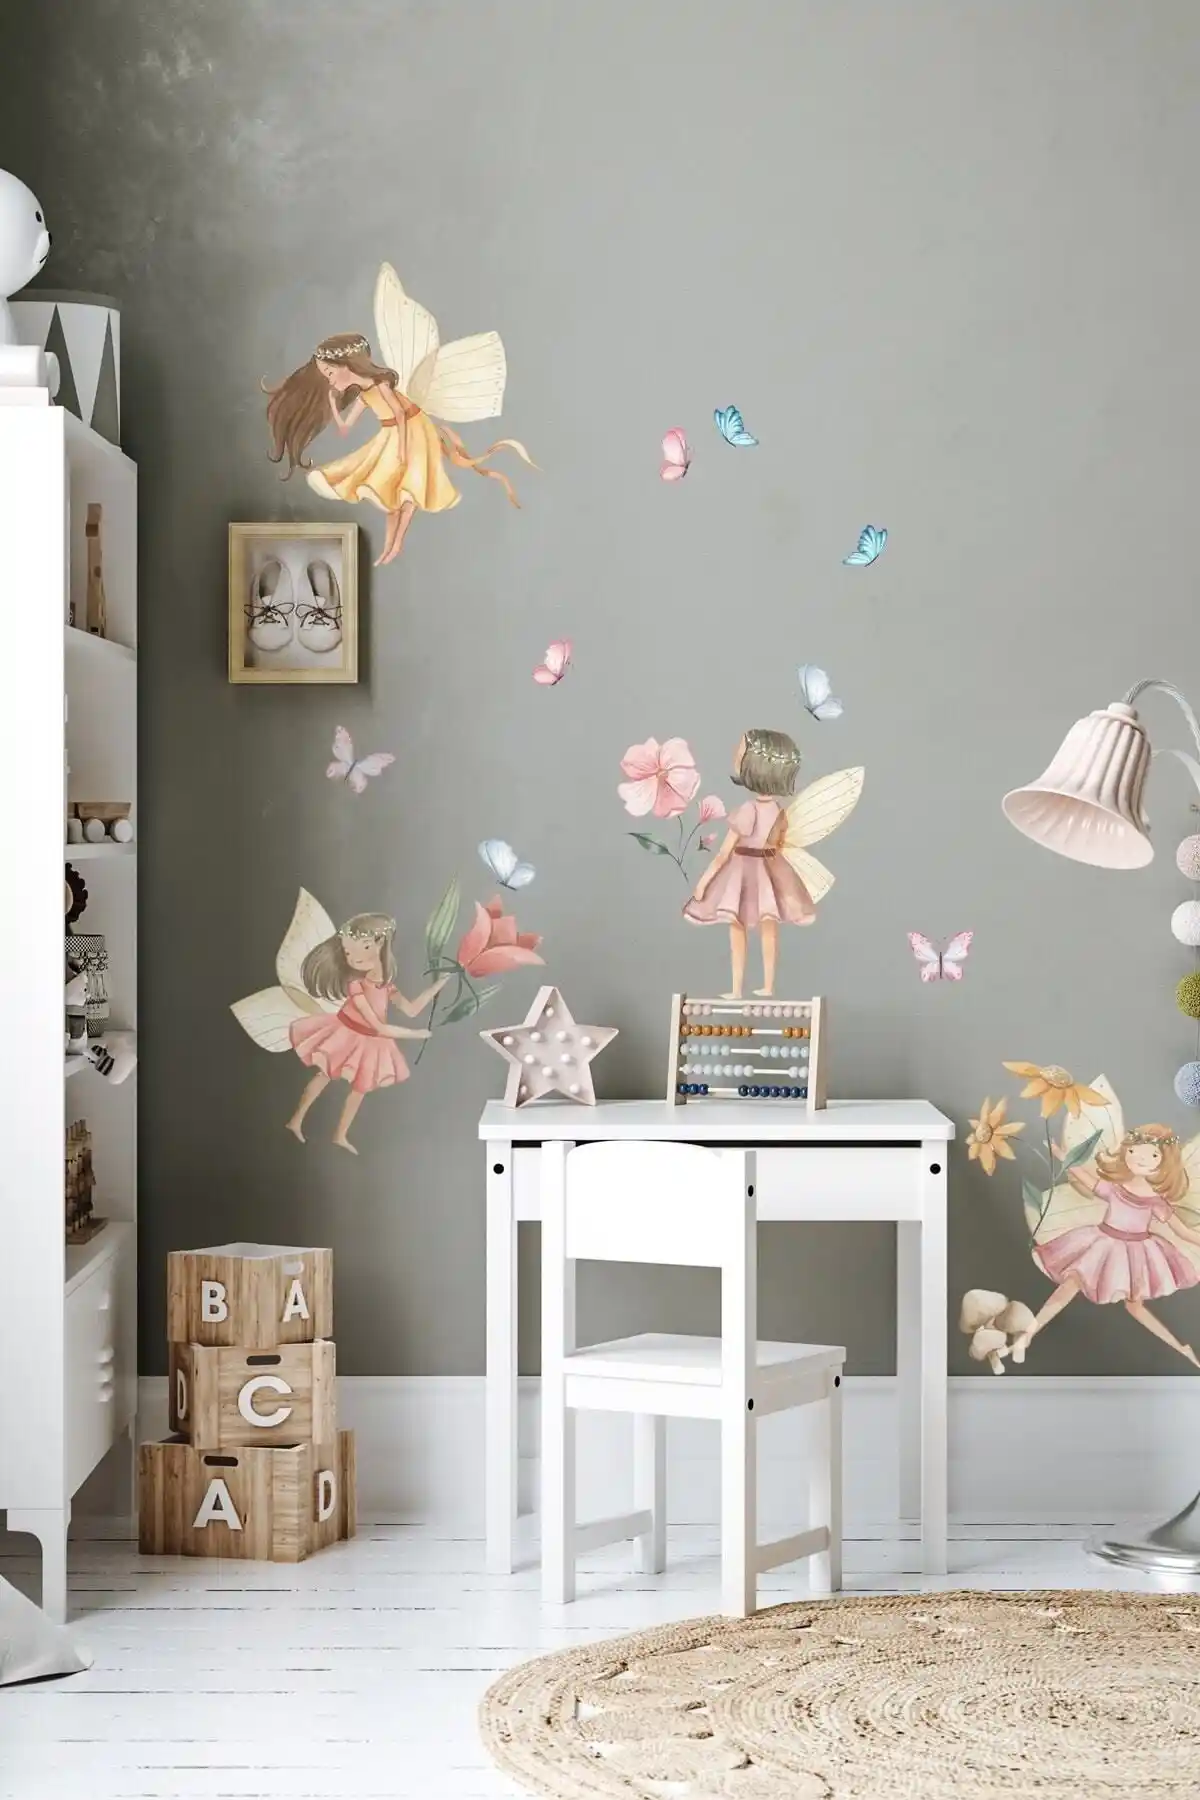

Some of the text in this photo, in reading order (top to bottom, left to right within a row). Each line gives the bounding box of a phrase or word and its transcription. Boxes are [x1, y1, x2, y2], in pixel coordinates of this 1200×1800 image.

[202, 1280, 228, 1323] B
[282, 1279, 310, 1323] A
[177, 1368, 187, 1420] D
[238, 1375, 292, 1427] C
[192, 1478, 243, 1530] A
[316, 1470, 336, 1522] D
